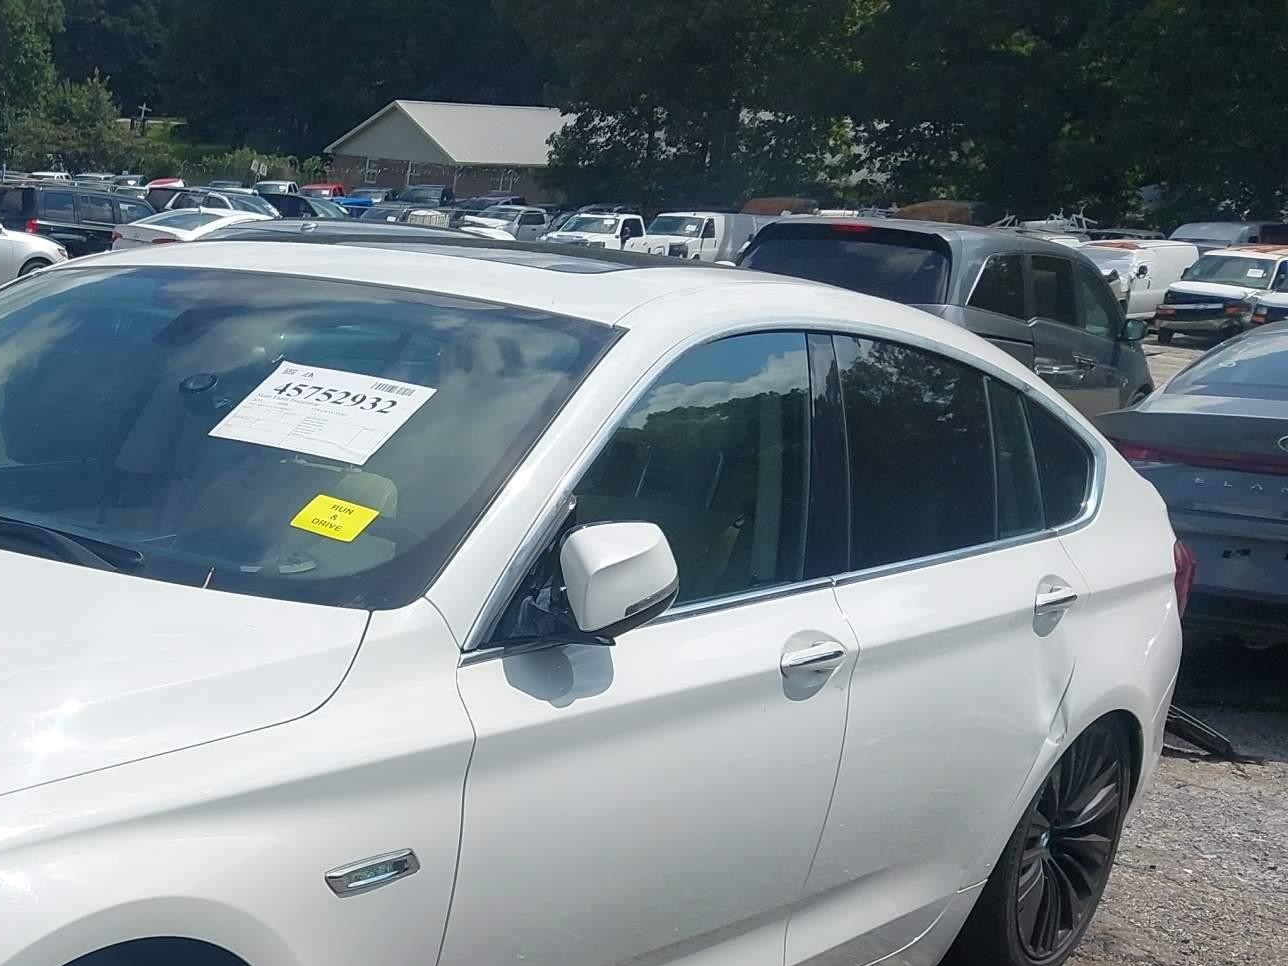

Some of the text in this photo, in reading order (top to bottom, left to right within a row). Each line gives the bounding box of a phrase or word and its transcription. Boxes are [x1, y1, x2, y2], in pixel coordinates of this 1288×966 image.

[273, 382, 397, 414] 45752932
[330, 504, 354, 515] RUN
[311, 517, 343, 532] DRIVE
